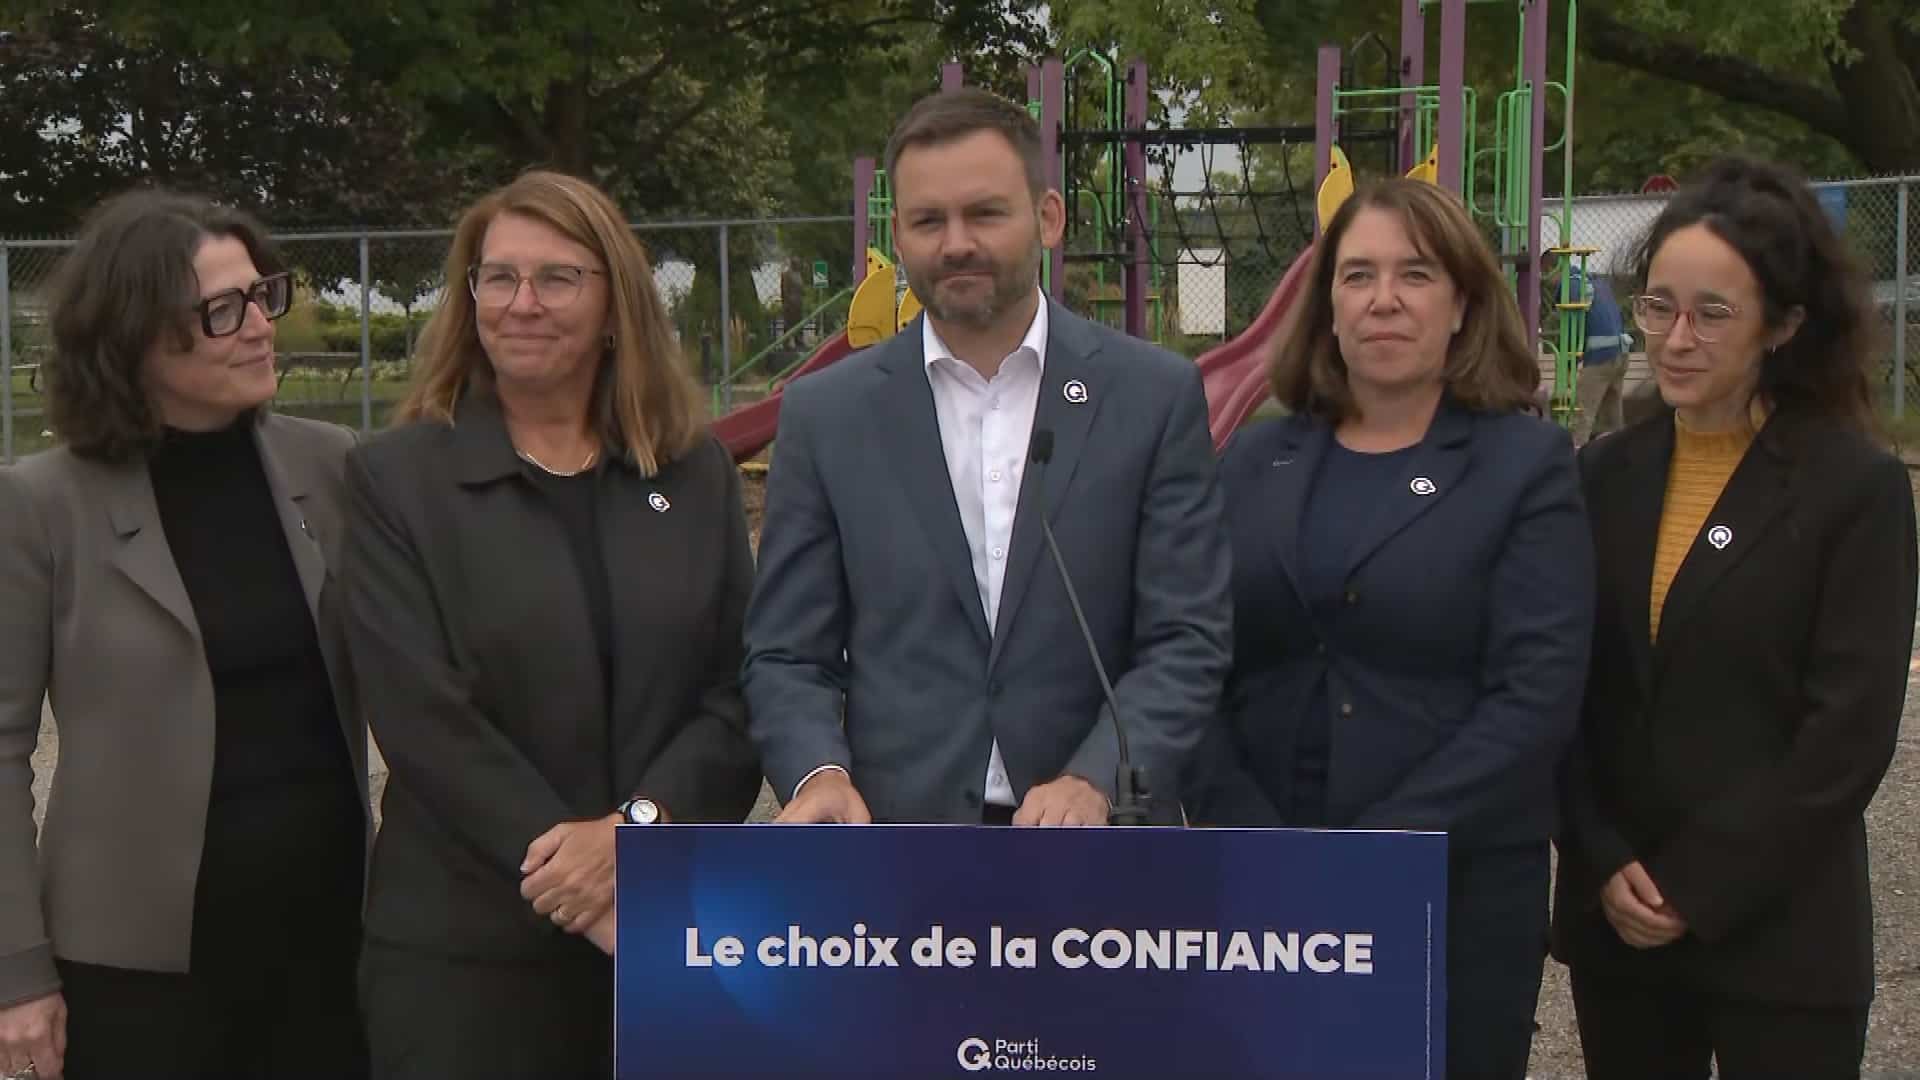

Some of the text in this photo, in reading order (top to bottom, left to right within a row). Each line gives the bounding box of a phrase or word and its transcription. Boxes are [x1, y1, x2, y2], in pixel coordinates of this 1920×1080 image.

[685, 923, 1373, 974] Le choix de la CONFIANCE
[995, 1038, 1039, 1054] Parti
[994, 1055, 1097, 1071] Québécois
